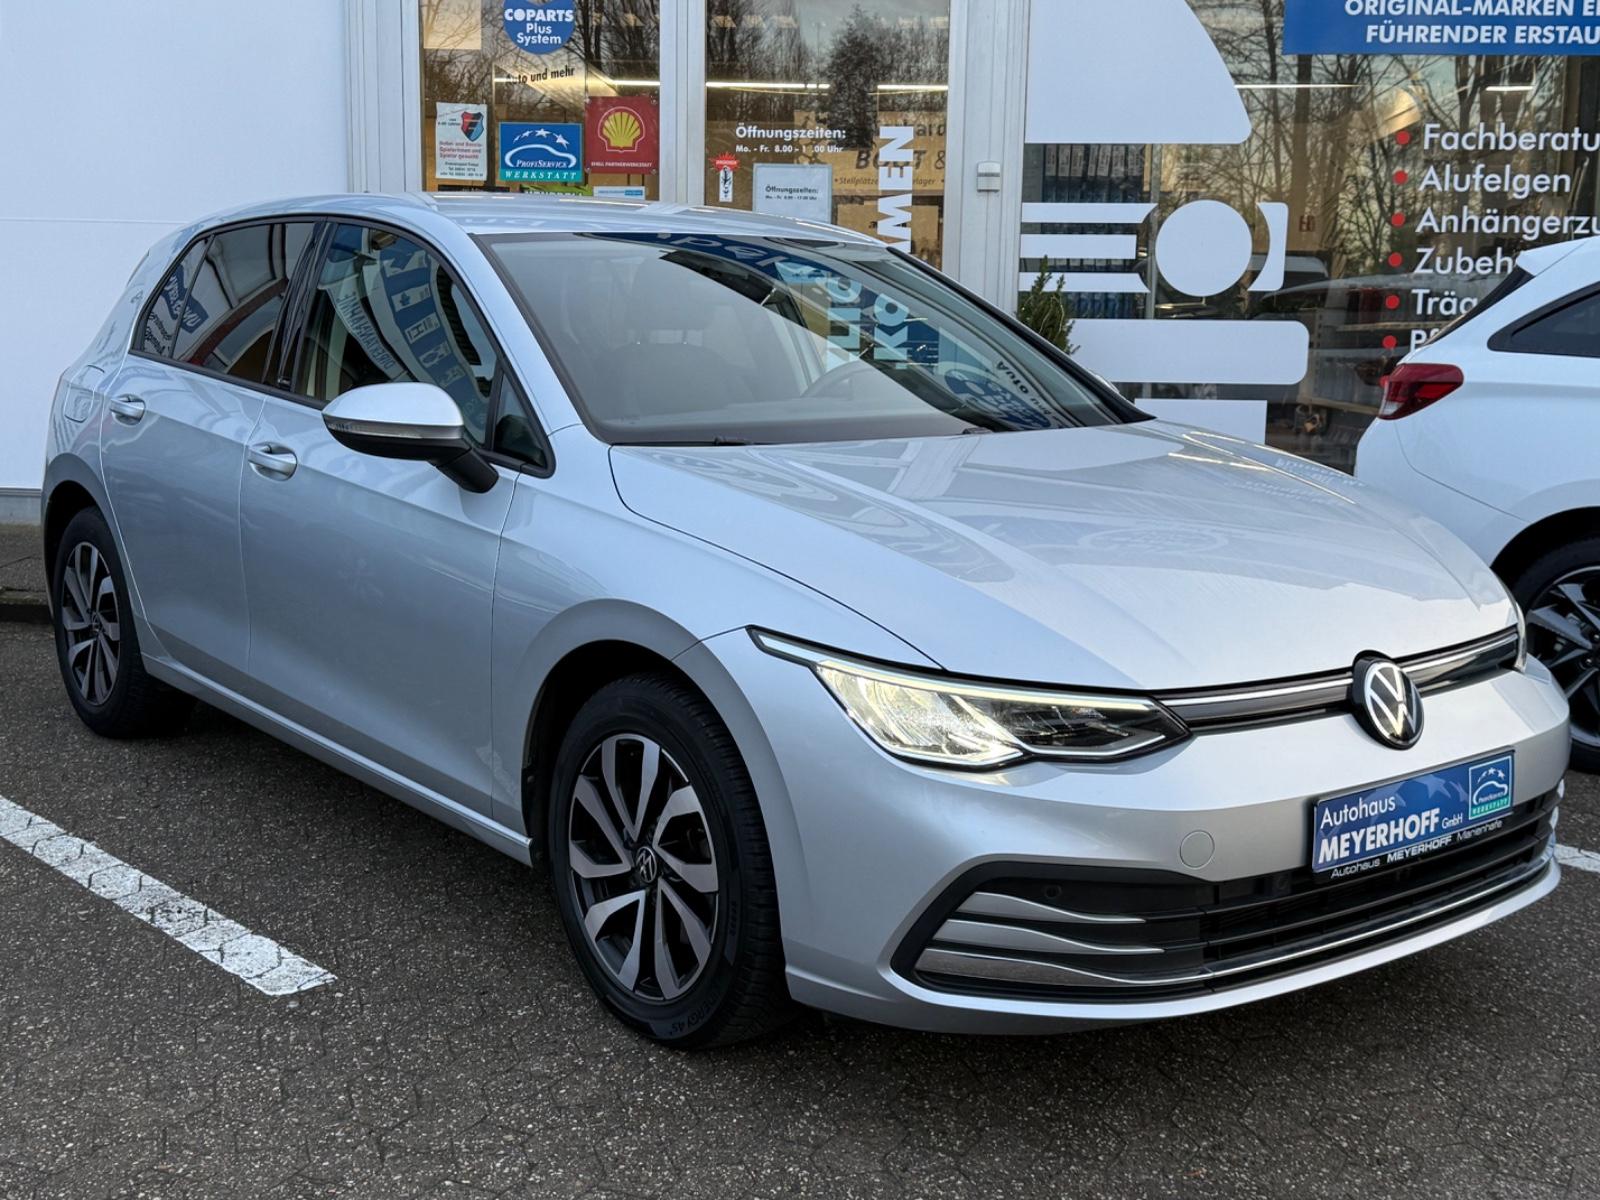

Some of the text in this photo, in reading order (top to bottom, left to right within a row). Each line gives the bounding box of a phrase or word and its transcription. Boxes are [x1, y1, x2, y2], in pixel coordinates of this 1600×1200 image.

[504, 8, 574, 22] COPARTS
[1344, 0, 1574, 16] ORIGINAL-MARKEN
[526, 23, 552, 34] Plus
[1366, 20, 1600, 44] FÜHRENDER ERSTAU
[517, 32, 561, 46] System
[530, 68, 548, 82] und
[551, 65, 575, 79] mehr
[735, 122, 847, 141] Öffnungszeiten:
[735, 145, 751, 153] Mo.
[759, 145, 770, 153] Fr.
[774, 145, 793, 153] 8.00
[826, 145, 844, 153] Uhr
[505, 170, 577, 180] WERKSTATT
[1418, 163, 1572, 199] Alufelgen
[1413, 247, 1514, 275] Zubeh
[1320, 796, 1396, 829] Autohaus
[1318, 808, 1464, 864] MEYERHOFF GmbH
[1331, 858, 1381, 879] Autohaus
[1386, 835, 1453, 863] MEYERHOFF
